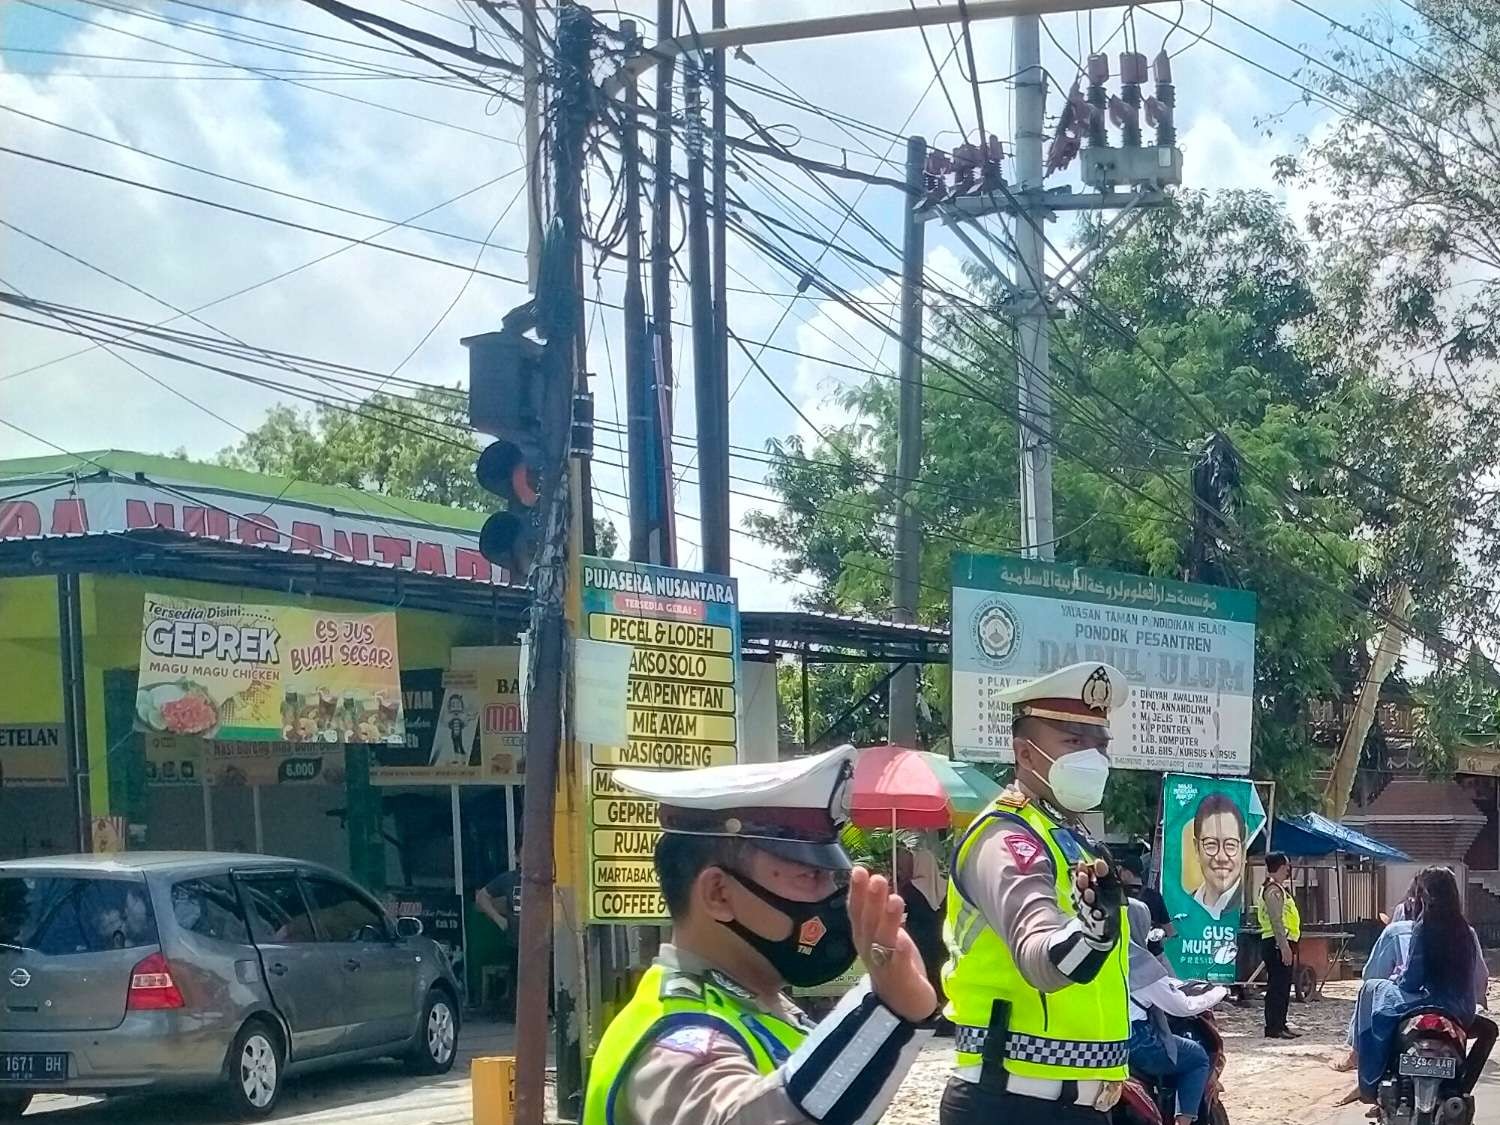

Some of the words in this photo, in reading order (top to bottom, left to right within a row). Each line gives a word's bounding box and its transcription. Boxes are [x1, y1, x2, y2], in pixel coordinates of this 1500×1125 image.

[126, 498, 510, 584] NUSANTAR
[584, 566, 654, 595] PUJASERA
[656, 576, 734, 603] NUSANTARA
[148, 600, 204, 620] Tersedia
[343, 621, 374, 645] JUS
[610, 618, 653, 642] PECEL
[655, 623, 666, 644] &
[668, 624, 713, 648] LODEH
[1142, 615, 1194, 632] PNDIDIKAN
[145, 619, 281, 664] GEPREK
[1075, 623, 1129, 645] PONDOK
[1136, 631, 1212, 653] PESANTREN
[290, 644, 336, 675] BUAH
[629, 651, 667, 674] AKSO
[669, 656, 706, 677] SOLO
[149, 662, 189, 675] MAGU
[192, 666, 229, 679] MAGU
[232, 669, 280, 681] CHICKEN
[497, 679, 519, 694] BA
[987, 676, 1011, 688] PLAY
[627, 680, 651, 703] EKA
[653, 683, 723, 708] PENYETAN
[1172, 692, 1208, 705] AWALIYAH
[633, 711, 657, 734] MIE
[660, 713, 697, 736] AYAM
[1140, 712, 1174, 724] MJELIS
[987, 724, 1012, 736] MADR
[1140, 723, 1191, 735] KPPONTREN
[286, 763, 314, 776] 6.000
[598, 866, 654, 883] MARTABAK
[602, 893, 655, 914] COFFEE
[1203, 925, 1235, 941] GUS
[7, 1056, 33, 1071] 1671
[45, 1056, 61, 1071] BH
